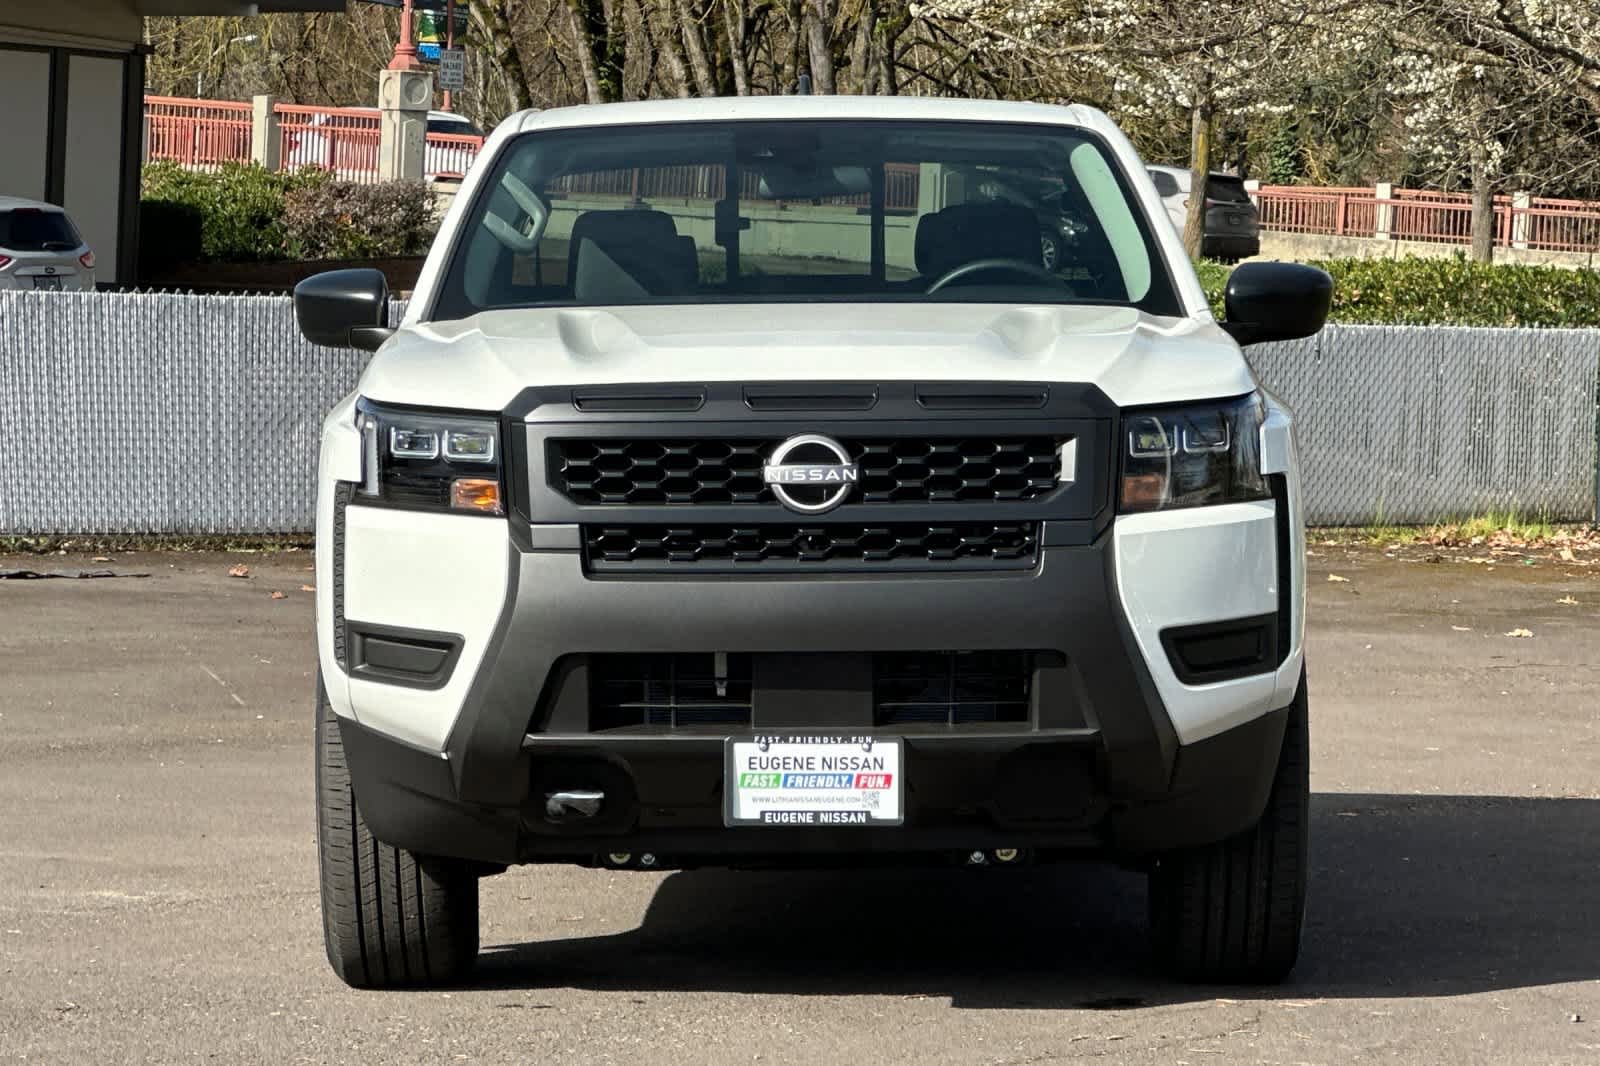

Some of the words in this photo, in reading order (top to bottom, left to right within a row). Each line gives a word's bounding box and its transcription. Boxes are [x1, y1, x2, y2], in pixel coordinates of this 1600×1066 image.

[767, 469, 857, 481] NISSAN
[748, 757, 816, 770] EUGENE
[821, 757, 884, 770] NISSAN
[744, 774, 778, 788] FAST.
[787, 774, 850, 788] FRIENDLY.
[860, 774, 890, 788] FUN.
[764, 812, 814, 823] EUGENE
[819, 812, 867, 823] NISSAN
